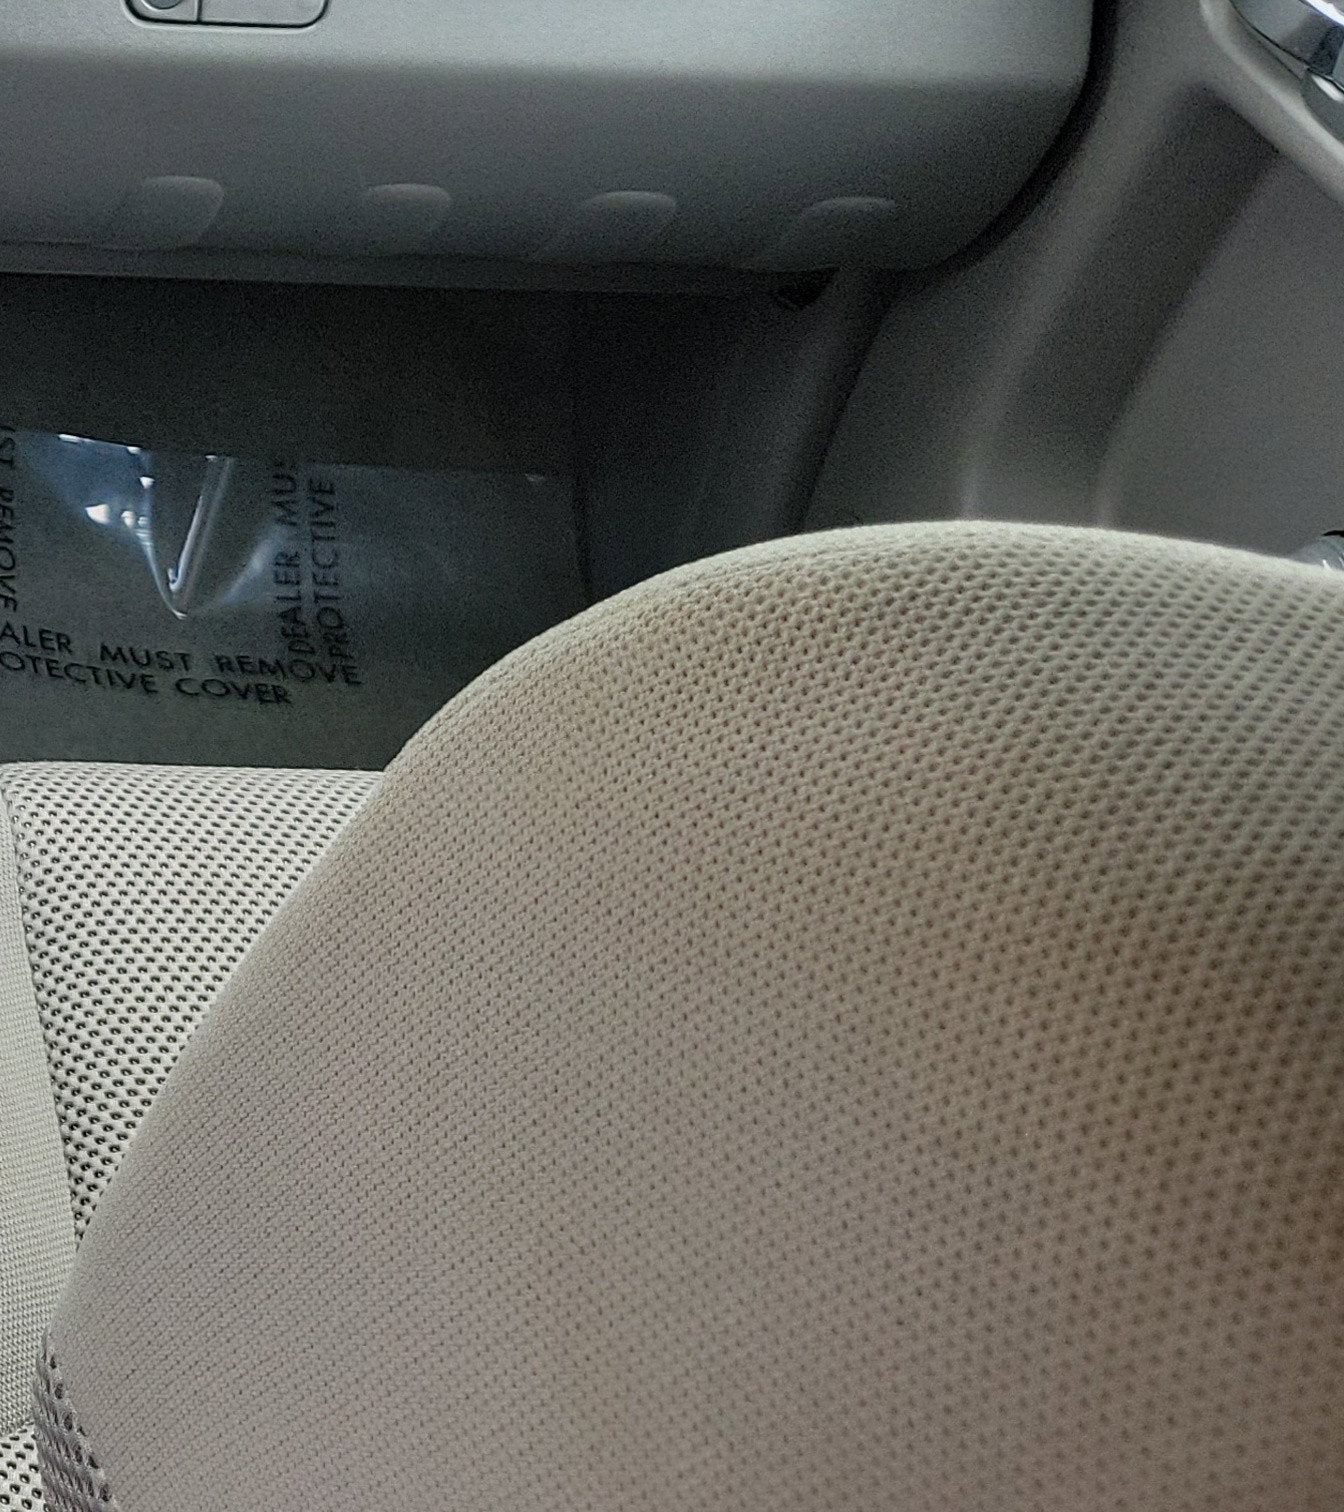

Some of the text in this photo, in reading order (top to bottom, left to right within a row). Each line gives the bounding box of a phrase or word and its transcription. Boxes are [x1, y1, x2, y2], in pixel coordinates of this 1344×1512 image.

[273, 551, 316, 654] DEALER
[310, 479, 354, 659] PROTECTIVE
[99, 643, 192, 672] MUST
[215, 653, 363, 687] REMOVE
[175, 676, 292, 705] COVER
